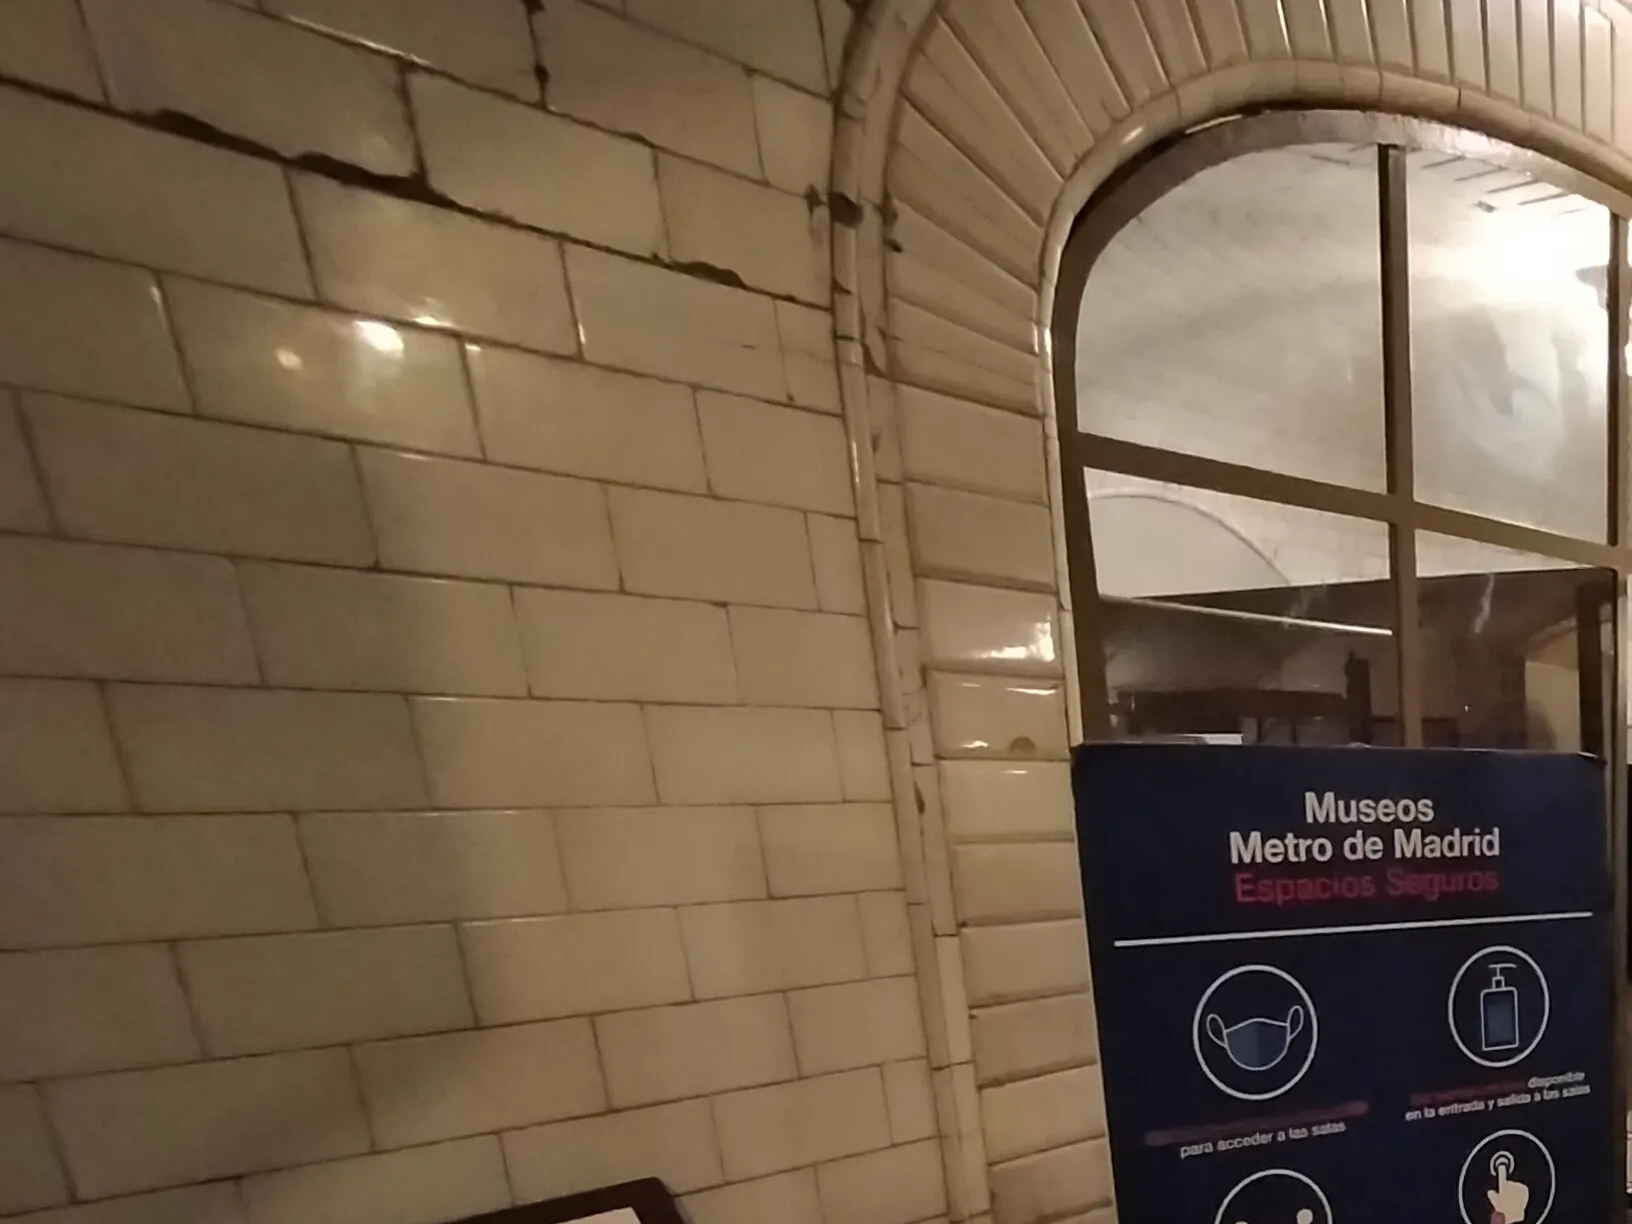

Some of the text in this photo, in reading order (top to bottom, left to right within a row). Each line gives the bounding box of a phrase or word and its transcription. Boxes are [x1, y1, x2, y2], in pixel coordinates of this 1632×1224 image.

[1305, 791, 1434, 823] Museos
[1229, 827, 1501, 864] Metro de Madrid
[1234, 867, 1500, 906] Espacios Seguros
[1405, 1109, 1422, 1121] en
[1437, 1101, 1486, 1116] entrada
[1487, 1100, 1496, 1111] y
[1179, 1120, 1346, 1159] para acceder a las salas
